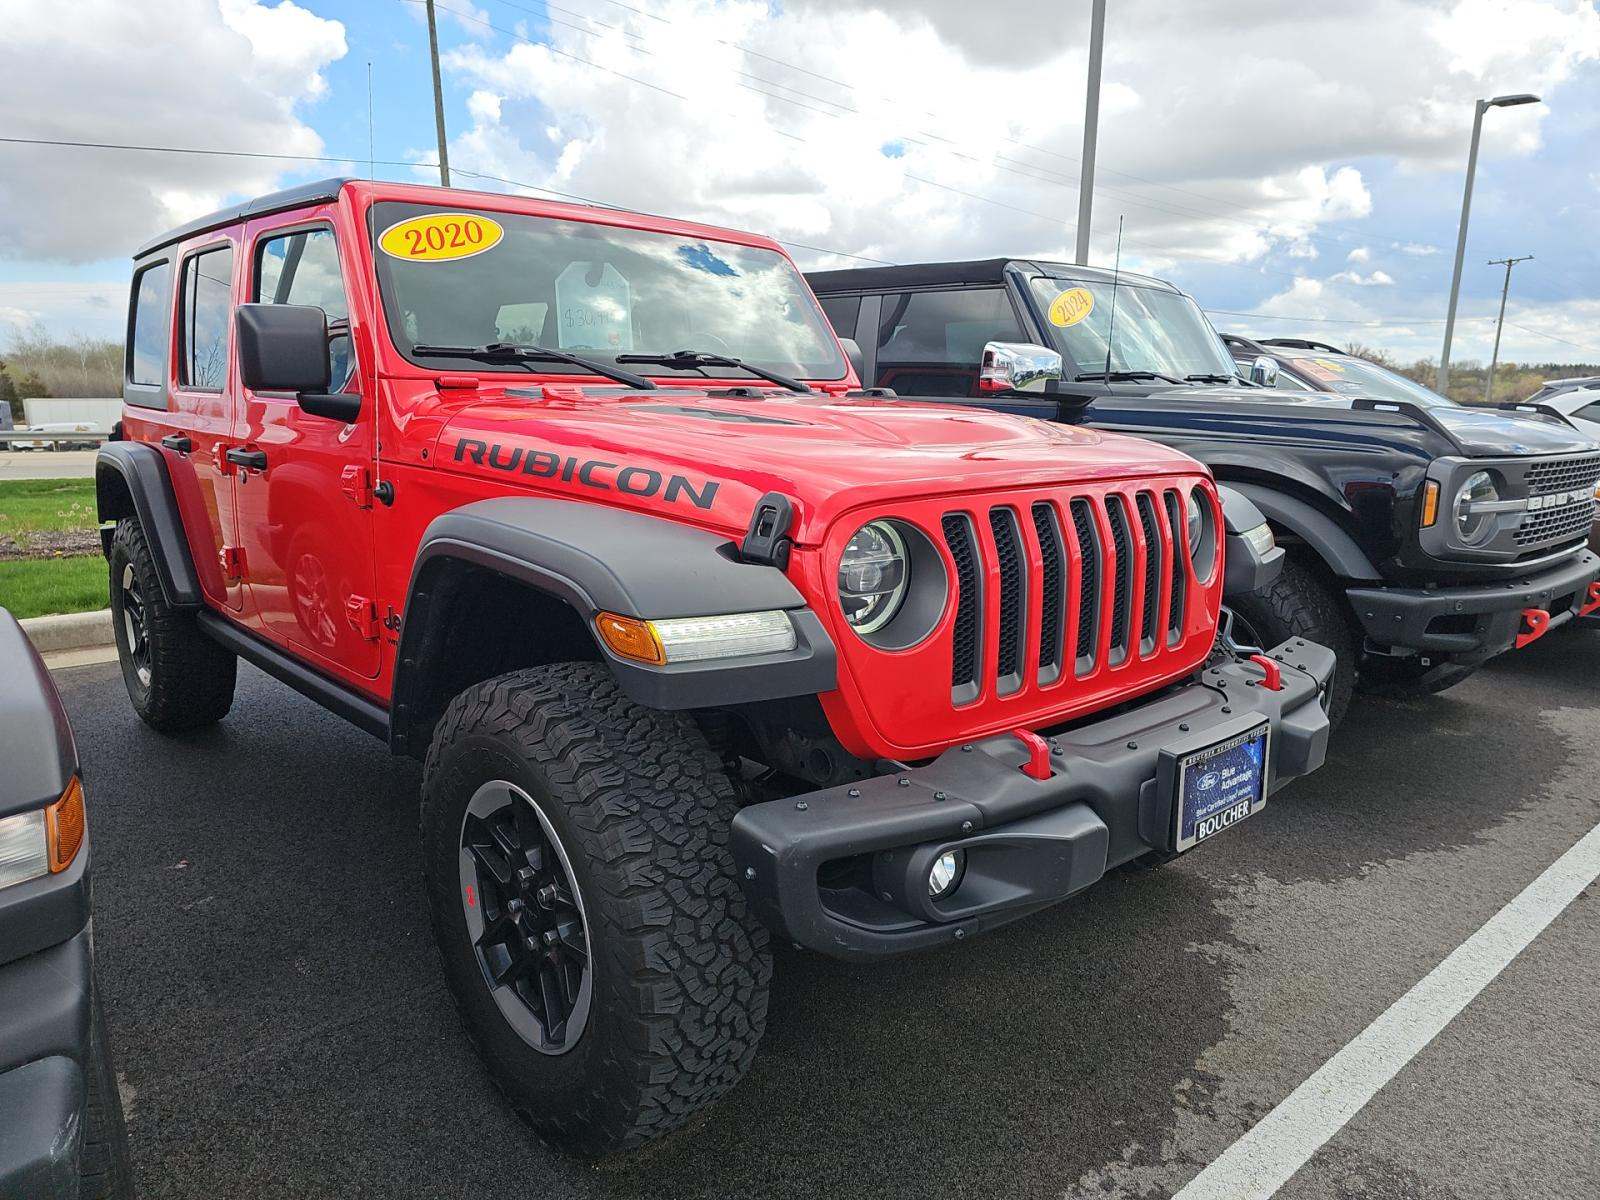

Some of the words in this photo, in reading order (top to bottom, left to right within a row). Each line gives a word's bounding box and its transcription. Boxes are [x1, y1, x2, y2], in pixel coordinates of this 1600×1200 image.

[404, 220, 483, 255] 2020
[1057, 291, 1089, 323] 2024
[454, 438, 721, 510] RUBICON
[1217, 736, 1249, 753] AUTOMOTIVE
[1221, 767, 1236, 779] Blue
[1221, 769, 1252, 791] Advantage
[1199, 801, 1249, 838] BOUCHER
